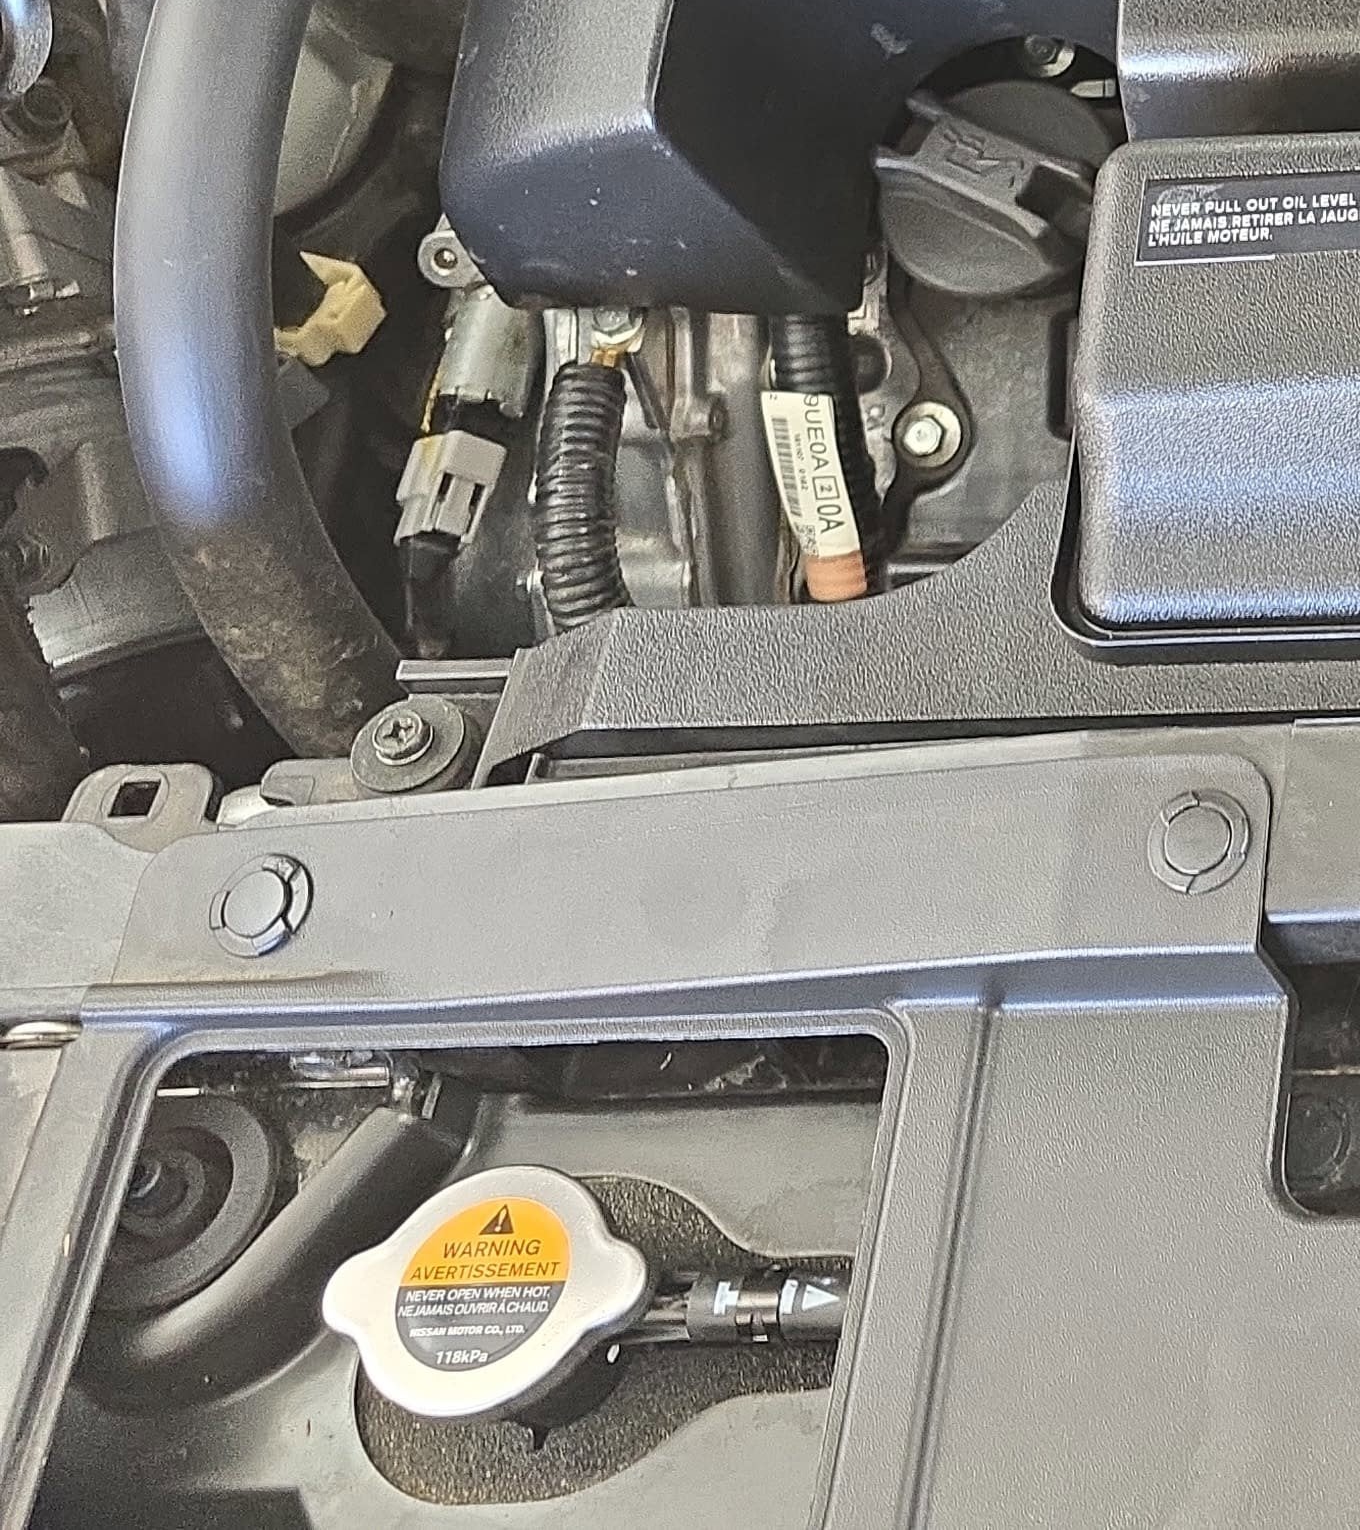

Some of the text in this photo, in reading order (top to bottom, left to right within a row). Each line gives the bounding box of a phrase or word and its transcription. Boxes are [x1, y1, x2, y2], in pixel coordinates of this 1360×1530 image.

[1151, 202, 1199, 217] NEVER
[1205, 199, 1240, 214] PULL
[1246, 197, 1277, 211] OUT
[1282, 196, 1307, 209] OIL
[1312, 193, 1356, 208] LEVEL
[1149, 219, 1169, 232] NE
[1232, 213, 1293, 227] RETIRER
[1299, 211, 1315, 224] LA
[1148, 227, 1272, 245] L'HUILE MOTEUR.
[443, 1239, 541, 1258] WARNING
[410, 1262, 560, 1280] AVERTISSEMENT
[404, 1286, 550, 1302] NEVER OPEN WHEN HOT.
[454, 1302, 496, 1315] OUVRIR
[507, 1301, 549, 1314] CHAUD.
[409, 1326, 446, 1337] NISSAN
[447, 1326, 482, 1336] MOTOR
[505, 1324, 526, 1334] LTD.
[435, 1349, 488, 1364] 118kPa
